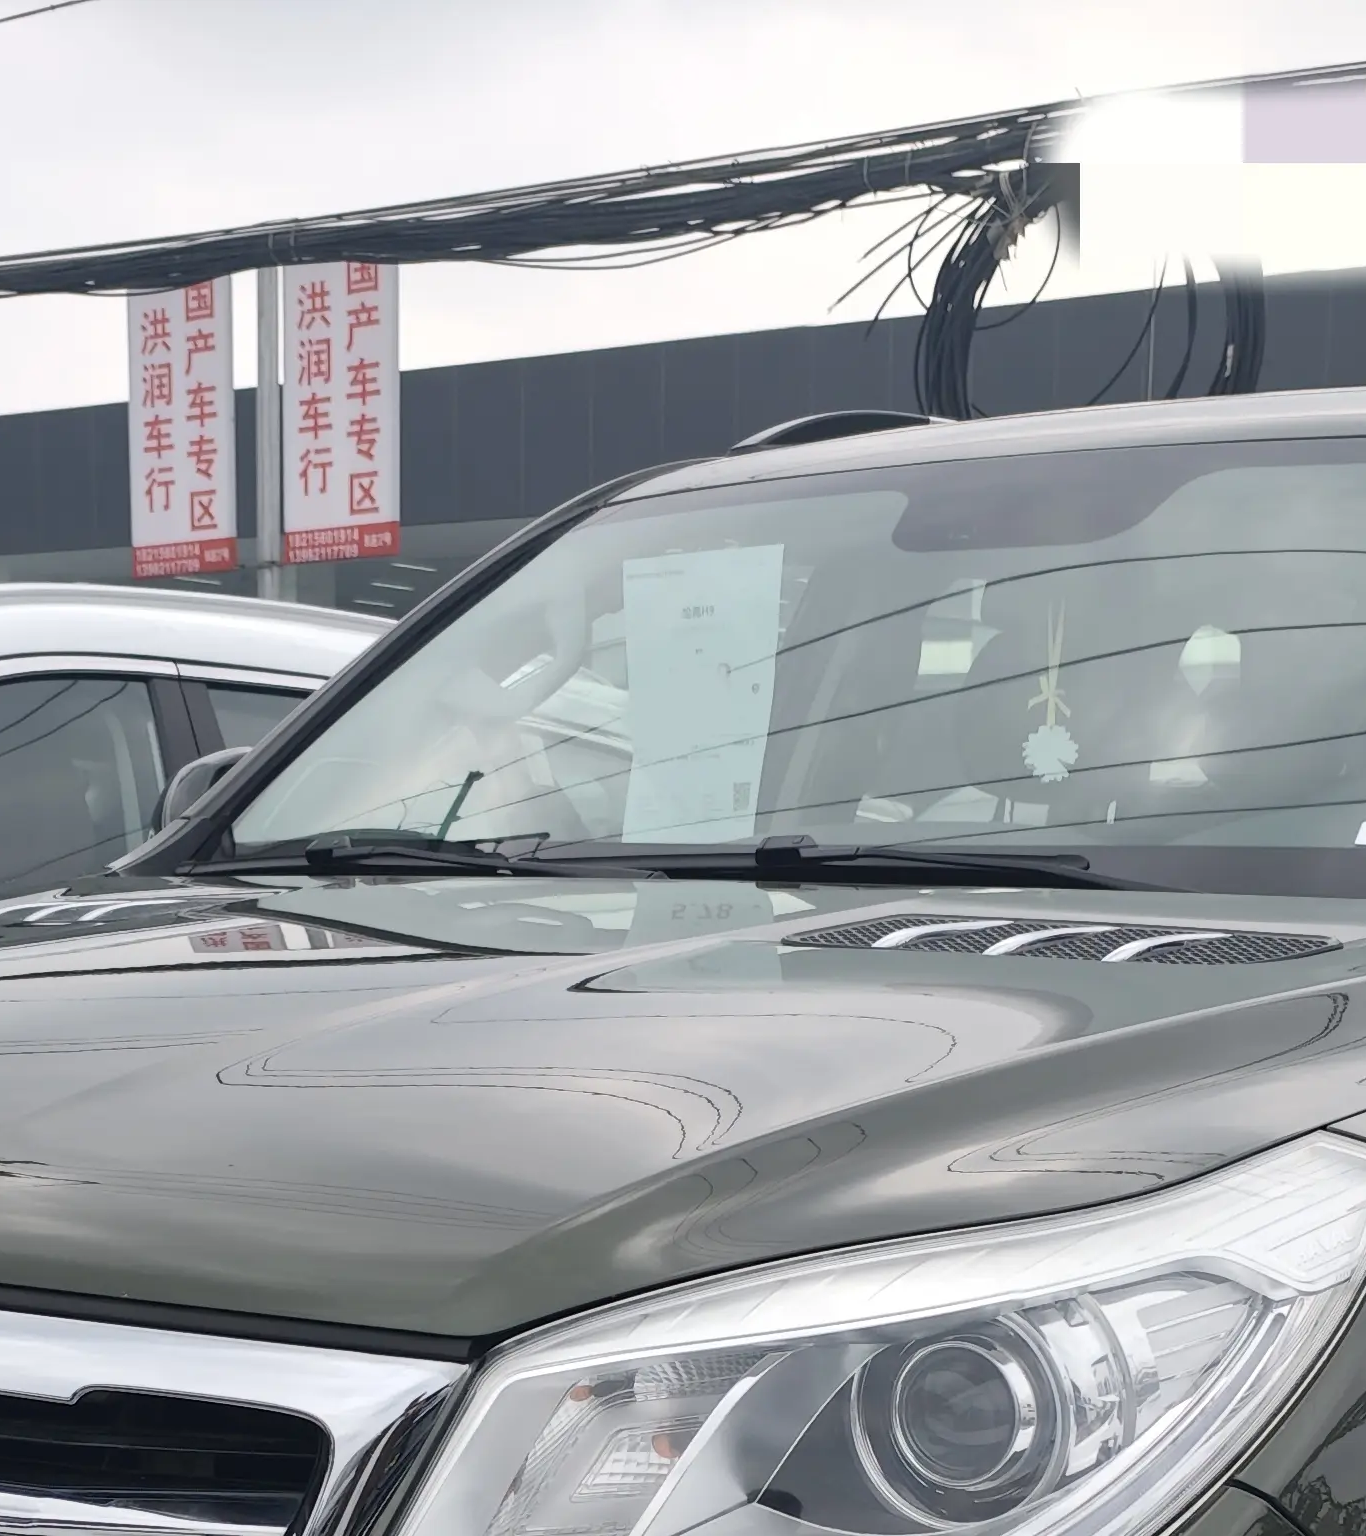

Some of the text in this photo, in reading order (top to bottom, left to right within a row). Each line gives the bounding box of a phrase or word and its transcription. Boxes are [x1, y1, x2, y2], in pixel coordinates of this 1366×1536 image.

[140, 308, 176, 513] 洪润车行
[184, 280, 219, 532] 国产车专区
[296, 280, 334, 497] 洪润车行
[346, 260, 383, 516] 国产车专区
